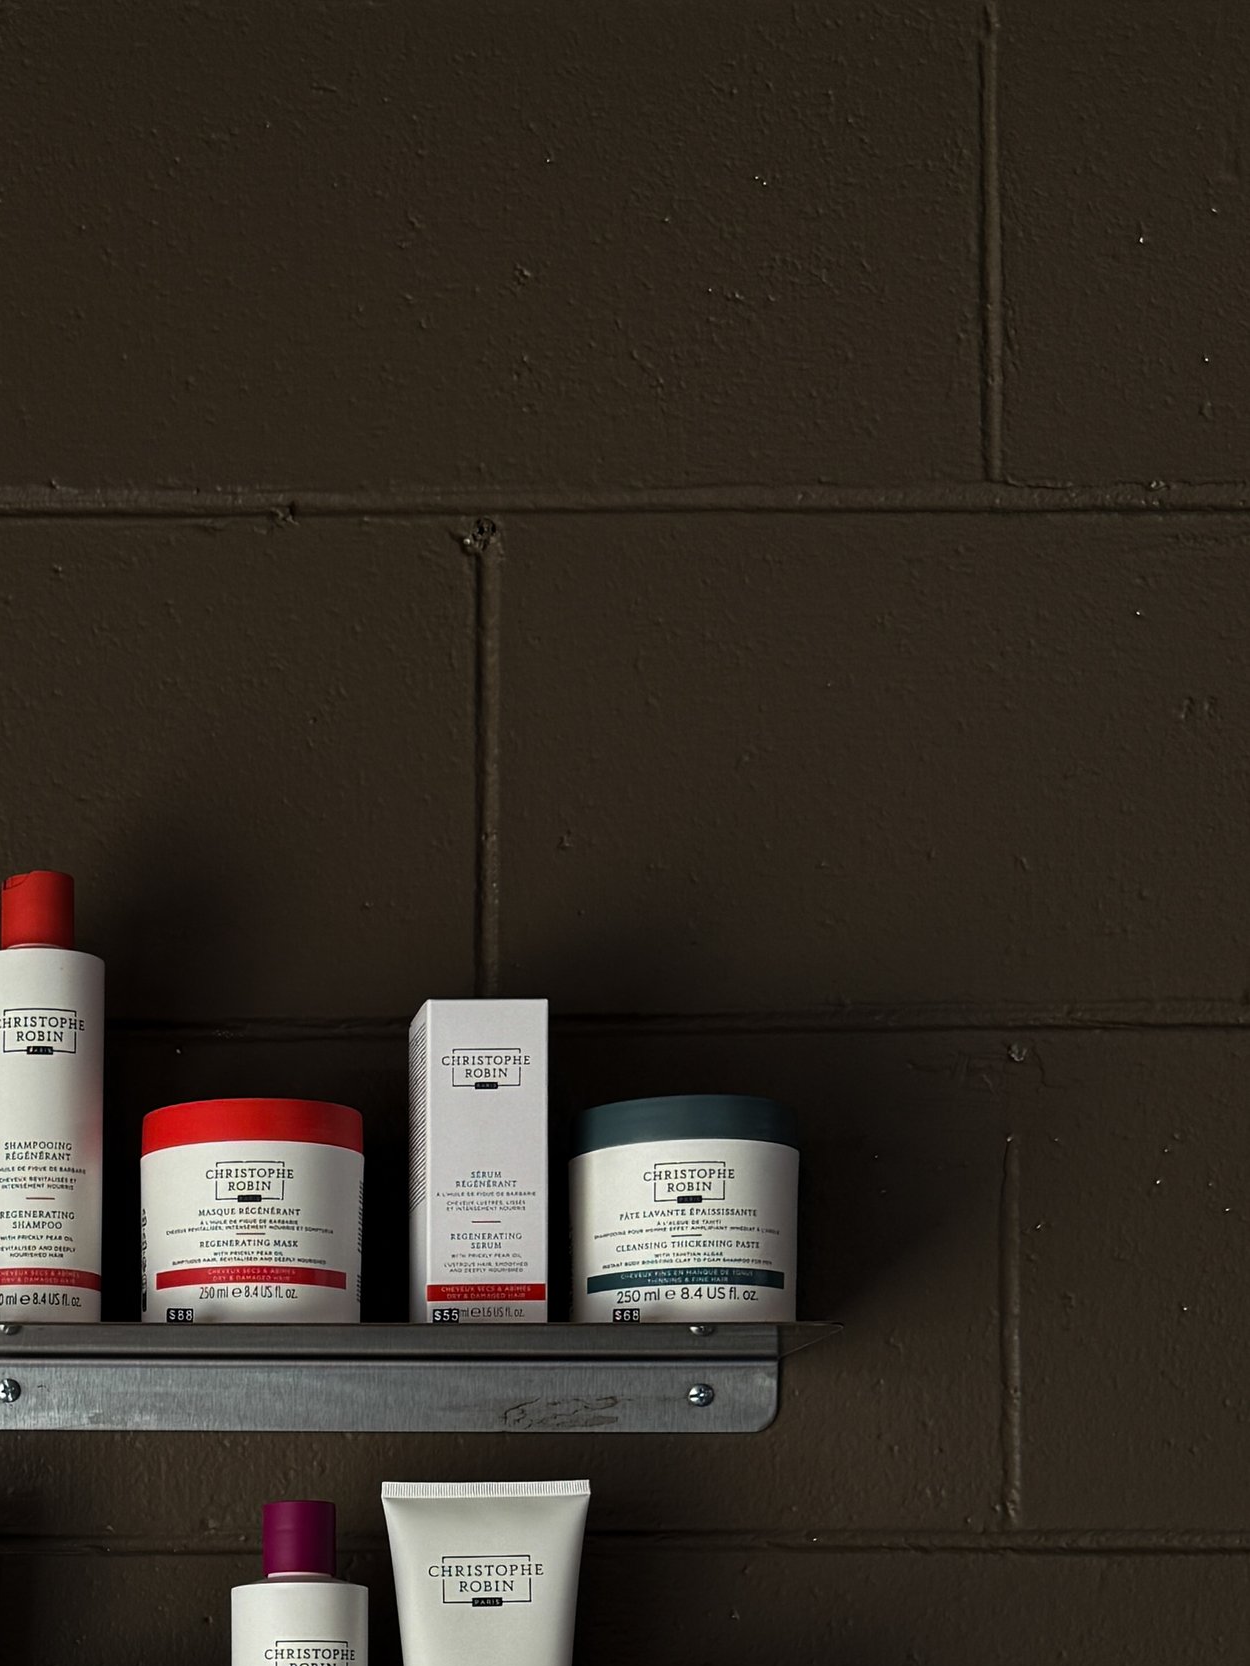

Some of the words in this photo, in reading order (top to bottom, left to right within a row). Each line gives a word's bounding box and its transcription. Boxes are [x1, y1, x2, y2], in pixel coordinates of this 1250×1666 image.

[16, 1031, 63, 1042] ROBIN
[442, 1056, 530, 1065] CHRISTOPHE
[465, 1068, 508, 1078] ROBIN
[4, 1142, 72, 1150] SHAMPOOING
[5, 1151, 71, 1161] RÉGÉNÉRANT
[206, 1168, 294, 1179] CHRISTOPHE
[643, 1169, 734, 1182] CHRISTOPHE
[228, 1181, 271, 1191] ROBIN
[667, 1182, 712, 1192] ROBIN
[0, 1211, 75, 1220] REGENERATING
[198, 1208, 235, 1217] MASQUE
[239, 1207, 301, 1216] RÉGÉNÉRANT
[12, 1221, 62, 1229] SHAMPOO
[200, 1240, 270, 1248] REGENERATING
[616, 1241, 667, 1252] CLEANSING
[671, 1240, 733, 1249] THICKENING
[736, 1240, 760, 1249] PASTE
[617, 1291, 640, 1304] 250
[644, 1288, 660, 1301] ml
[681, 1287, 703, 1299] 8.4
[707, 1287, 725, 1299] US
[729, 1287, 739, 1300] fl.
[743, 1291, 758, 1301] oz.
[428, 1564, 544, 1577] CHRISTOPHE
[459, 1580, 514, 1592] ROBIN
[264, 1649, 355, 1661] CHRISTOPHE
